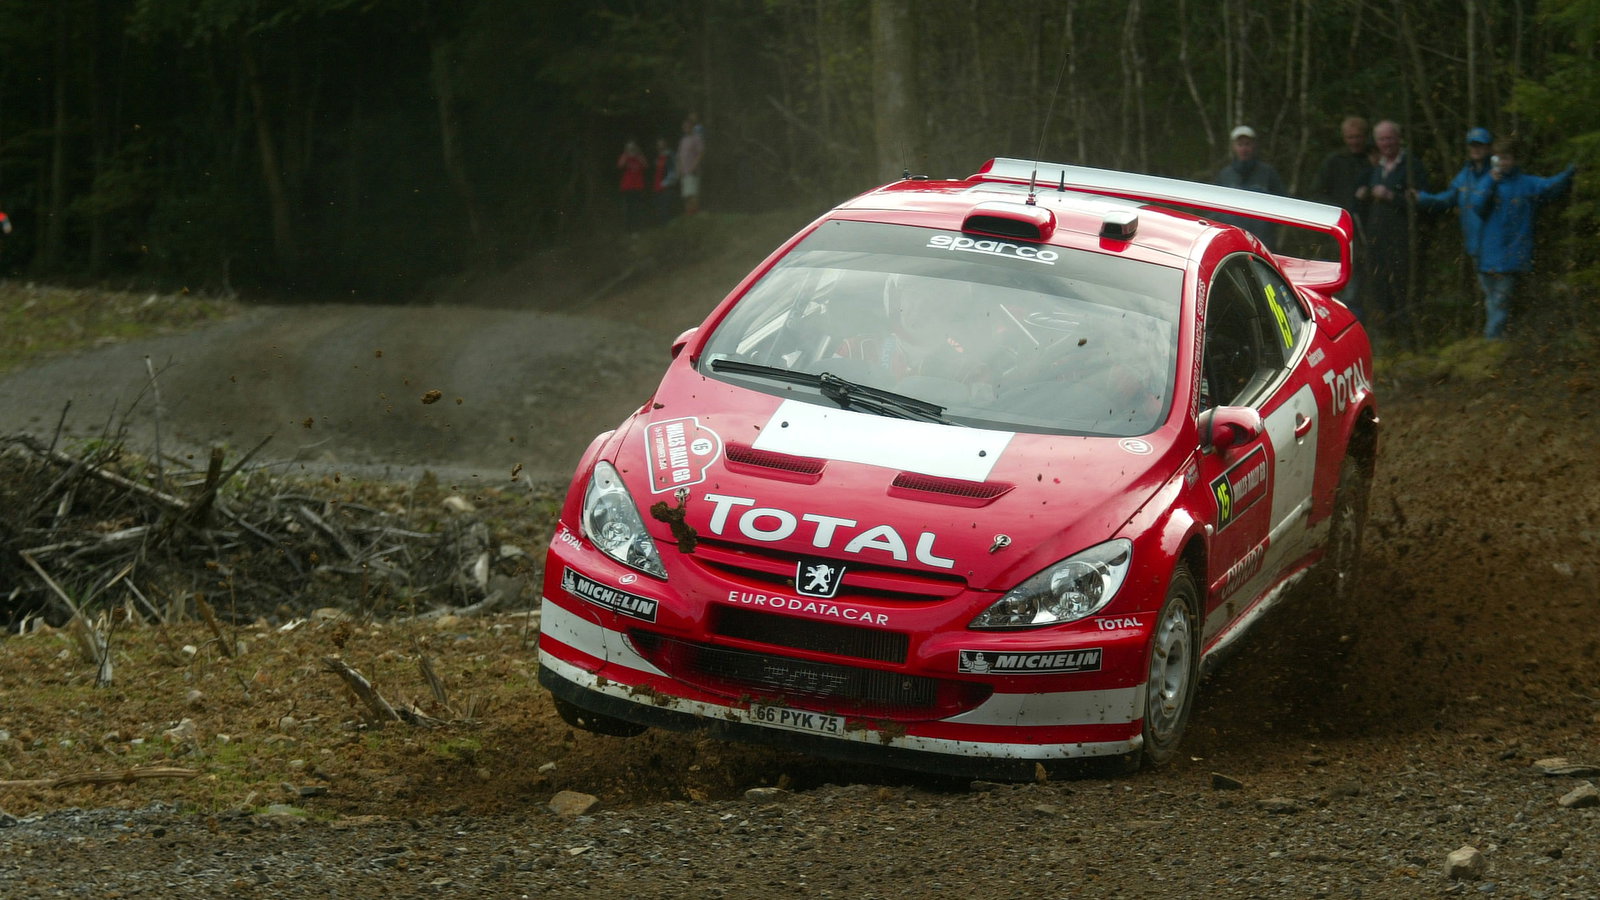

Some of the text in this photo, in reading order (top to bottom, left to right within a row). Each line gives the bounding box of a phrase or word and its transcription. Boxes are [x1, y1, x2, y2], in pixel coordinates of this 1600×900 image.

[926, 234, 1059, 265] sparco
[1196, 278, 1206, 319] SERVICES
[1264, 283, 1294, 349] 15
[1322, 357, 1372, 416] TOTAL
[666, 423, 691, 483] WALES RALLY GB
[693, 442, 709, 451] 15
[1217, 482, 1231, 522] 15
[559, 527, 583, 551] TOTAL
[703, 493, 955, 569] TOTAL
[577, 579, 655, 616] MICHELIN
[727, 590, 889, 626] EURODATACAR
[1094, 616, 1144, 631] TOTAL
[994, 651, 1100, 669] MICHELIN
[780, 710, 813, 729] PYK
[818, 716, 838, 732] 75
